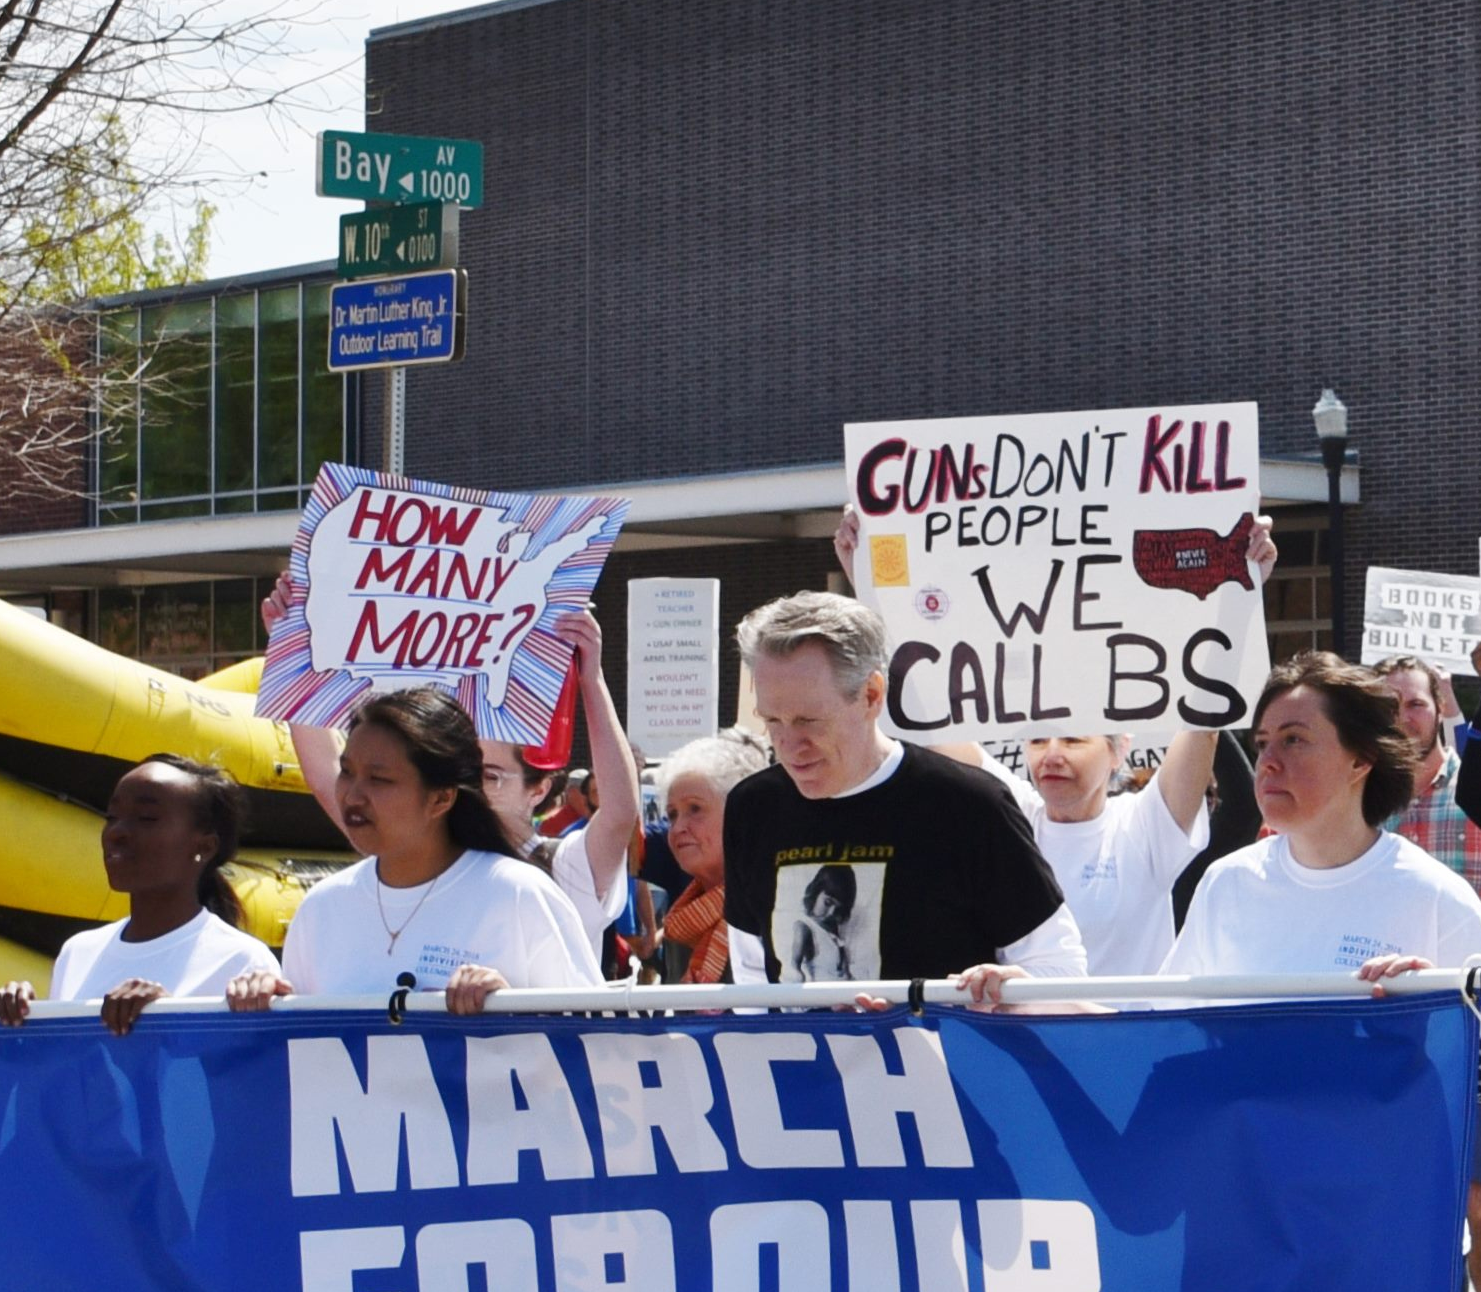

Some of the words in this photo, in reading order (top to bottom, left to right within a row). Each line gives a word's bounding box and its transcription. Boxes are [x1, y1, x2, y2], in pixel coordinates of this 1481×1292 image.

[335, 140, 392, 195] Bay
[436, 146, 456, 166] AV
[421, 170, 470, 200] 1000
[344, 225, 360, 264] W.
[365, 222, 391, 261] 10th
[418, 209, 428, 228] ST
[408, 233, 436, 263] 0100
[335, 307, 348, 328] Dr.
[349, 304, 379, 326] Martin
[379, 301, 411, 323] Luther
[436, 295, 450, 317] Jr.
[339, 334, 376, 356] Outdoor
[377, 328, 418, 355] Learning
[421, 324, 443, 347] Trail
[348, 489, 483, 546] HOW
[925, 505, 1112, 552] PEOPLE
[354, 549, 519, 603] MANY
[1177, 559, 1206, 568] AGAIN
[661, 590, 695, 598] RETIRED
[971, 555, 1123, 639] WE
[1388, 589, 1473, 610] BOOKS
[656, 605, 695, 613] TEACHER
[1411, 611, 1459, 630] NOT
[346, 599, 535, 670] MORE?
[652, 620, 671, 628] GUN
[673, 619, 702, 627] OWNER
[1368, 629, 1473, 655] BULLET
[669, 654, 708, 662] TRAINING
[644, 689, 668, 697] WANT
[670, 689, 682, 697] OR
[685, 688, 707, 697] NEED
[886, 641, 1072, 731] CALL
[1103, 628, 1248, 728] BS
[661, 704, 679, 712] GUN
[648, 719, 674, 727] CLASS
[676, 718, 702, 726] ROOM
[775, 842, 833, 865] pearl
[841, 841, 895, 860] jam
[423, 944, 450, 954] MARCH
[1342, 934, 1370, 948] MARCH
[1385, 942, 1403, 954] 2018
[287, 1027, 975, 1197] MARCH
